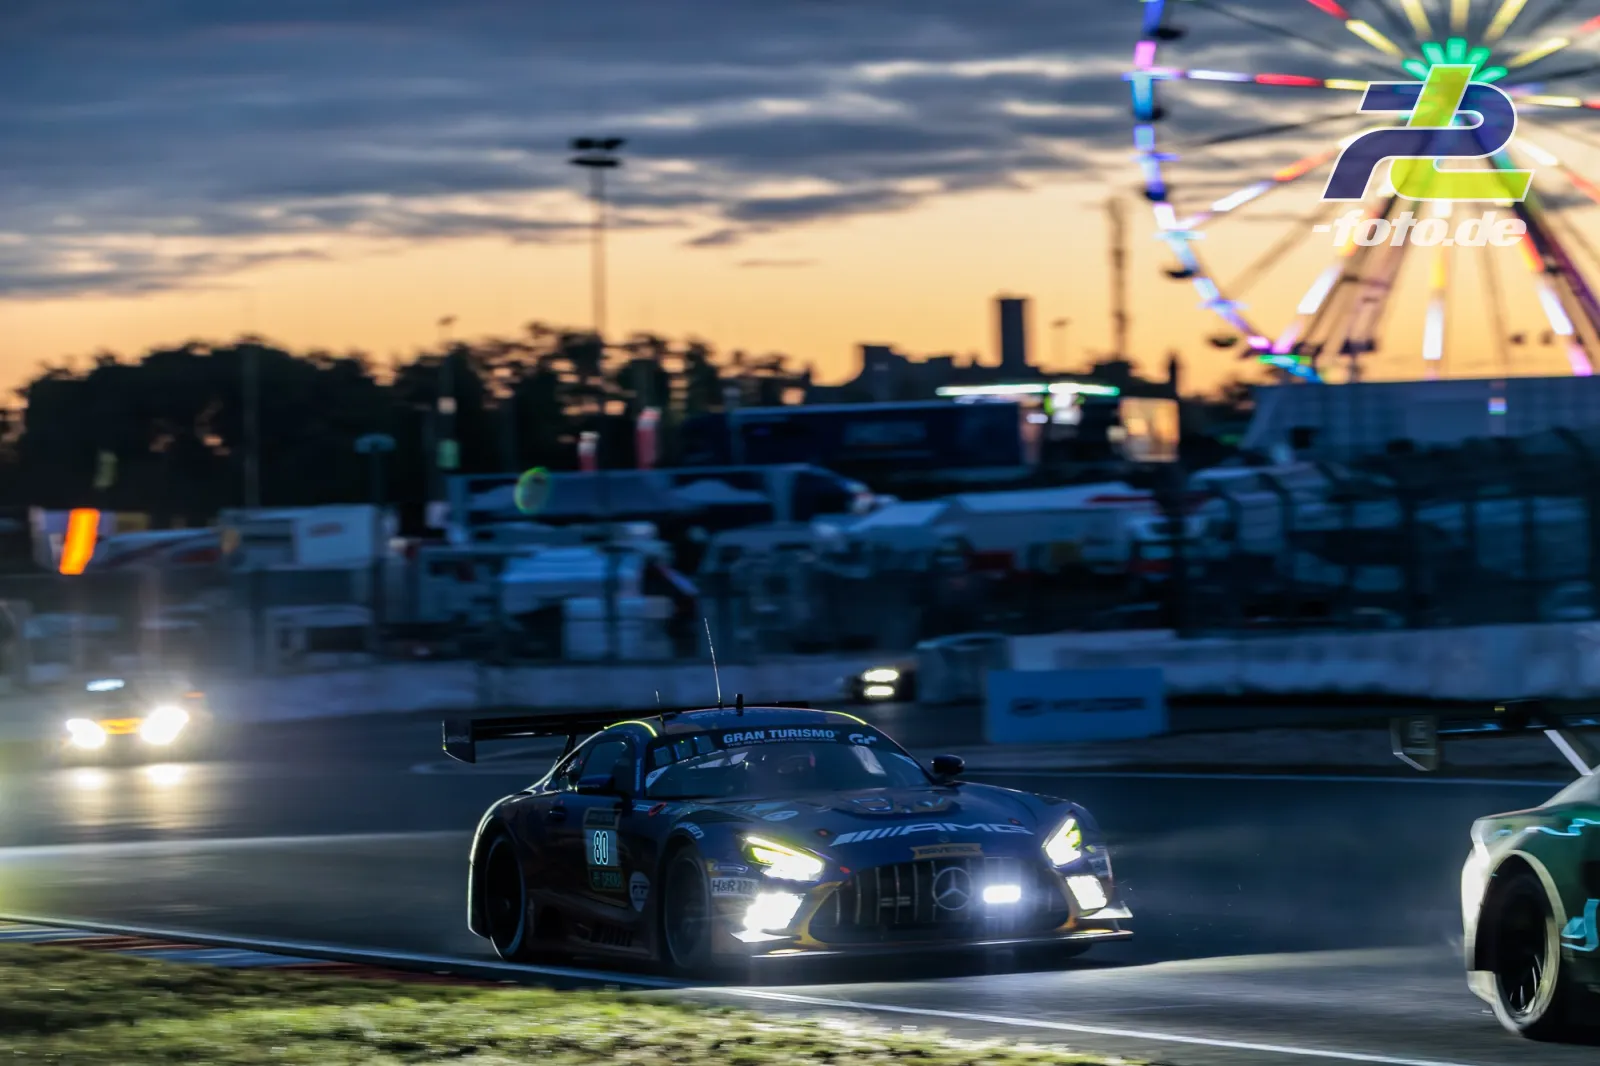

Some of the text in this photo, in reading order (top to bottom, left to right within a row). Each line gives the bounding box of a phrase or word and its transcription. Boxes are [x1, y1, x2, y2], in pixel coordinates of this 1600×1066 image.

[723, 730, 765, 744] GRAN
[768, 729, 835, 738] TURISMO
[900, 822, 1034, 836] AMG
[593, 830, 609, 866] 80
